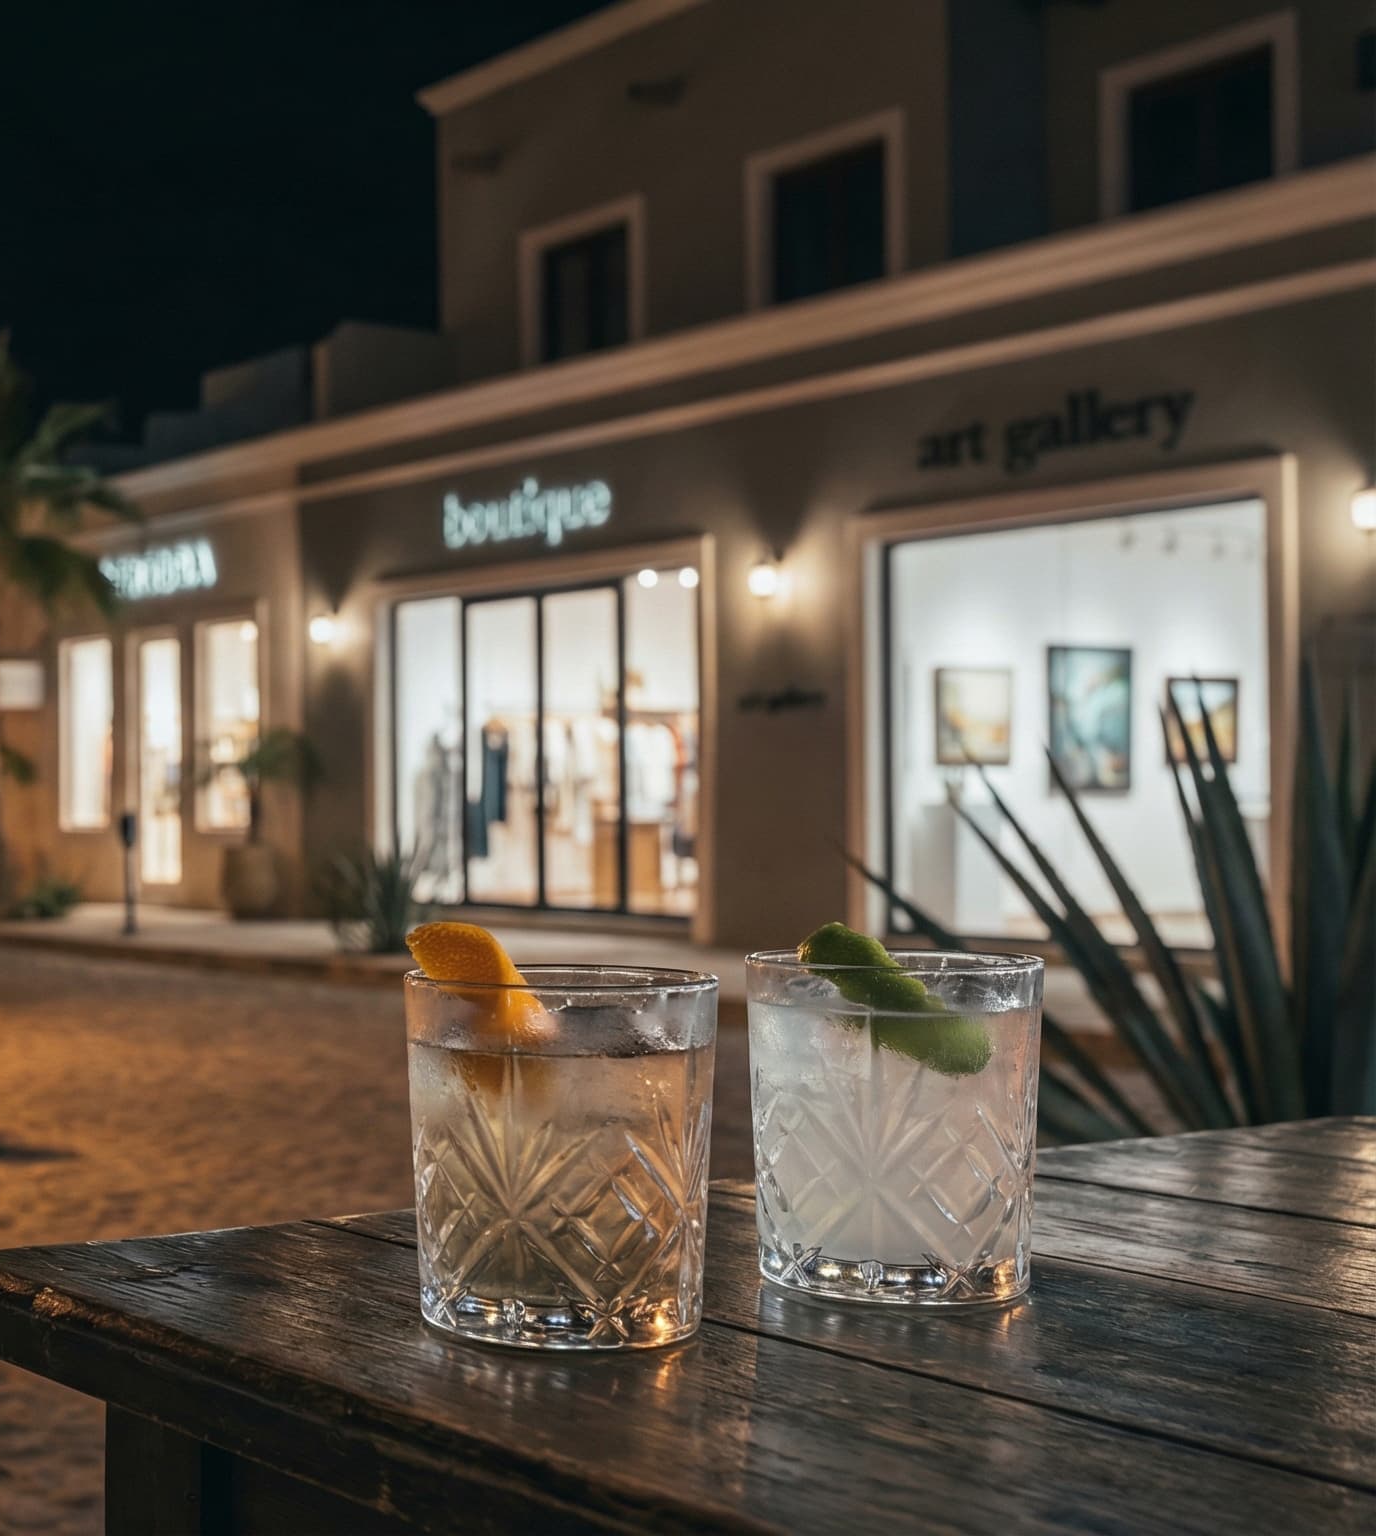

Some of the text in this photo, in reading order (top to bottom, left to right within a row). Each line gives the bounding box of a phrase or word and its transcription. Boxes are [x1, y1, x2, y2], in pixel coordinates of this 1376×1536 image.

[917, 388, 1195, 474] art gallery
[444, 477, 612, 549] boutique
